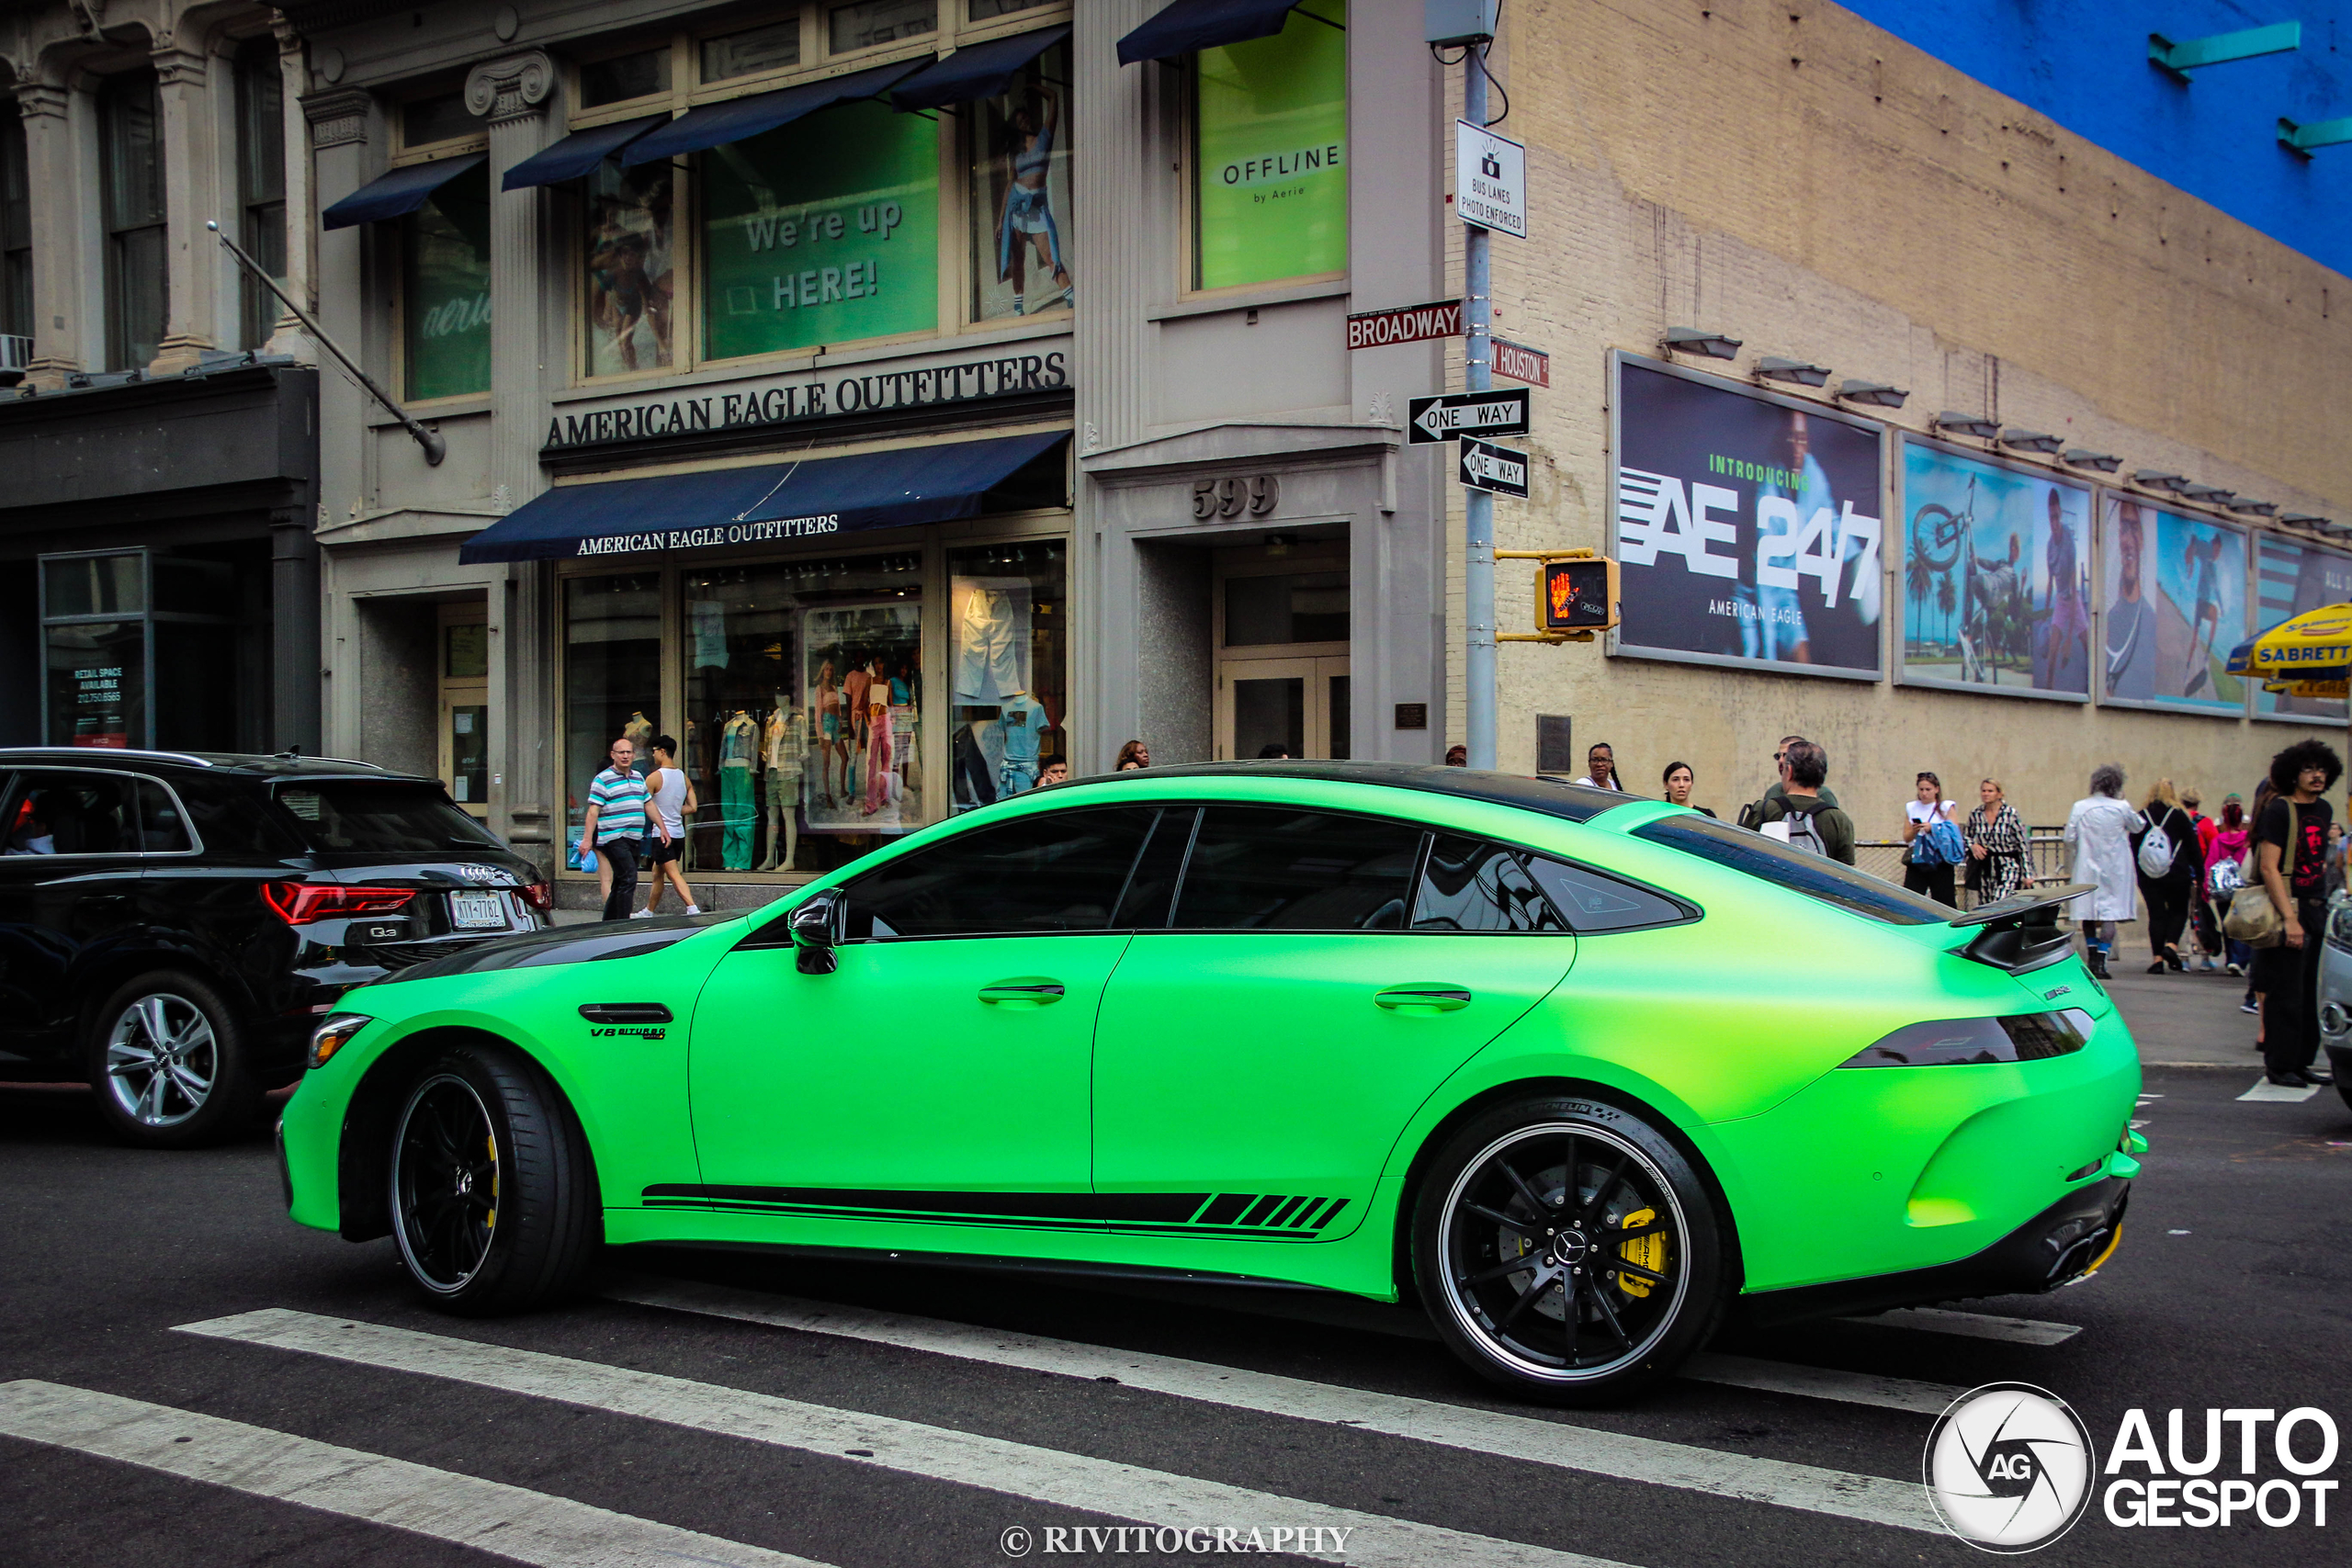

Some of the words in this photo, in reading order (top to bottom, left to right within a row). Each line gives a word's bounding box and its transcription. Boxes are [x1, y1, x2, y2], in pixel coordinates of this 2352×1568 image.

[1224, 145, 1339, 185] OFFLINE
[1254, 194, 1266, 204] by
[1272, 186, 1305, 199] Aerie
[1472, 178, 1486, 196] BUS
[1488, 184, 1510, 205] LANES
[745, 208, 844, 254] We're
[857, 200, 901, 242] up
[1462, 196, 1484, 217] PHOTO
[1486, 205, 1521, 230] ENFORCED
[774, 260, 877, 311] HERE!
[1349, 306, 1460, 347] BROADWAY
[1500, 346, 1541, 382] HOUSTON
[543, 397, 713, 448] AMERICAN
[721, 382, 826, 427] EAGLE
[835, 352, 1068, 413] OUTFITTERS
[1427, 409, 1461, 429] ONE
[1477, 404, 1514, 424] WAY
[1470, 454, 1489, 475] ONE
[1498, 461, 1521, 482] WAY
[1709, 454, 1810, 492] INTRODUCING
[1193, 475, 1280, 518] 599
[577, 533, 665, 556] AMERICAN
[669, 528, 725, 549] EAGLE
[729, 514, 839, 543] OUTFITTERS
[1757, 495, 1881, 609] 24/7
[1708, 599, 1766, 621] AMERICAN
[1771, 606, 1803, 626] EAGLE
[2259, 645, 2351, 663] SABRETT
[74, 670, 98, 679] RETAIL
[99, 667, 122, 678] SPACE
[80, 679, 119, 690] AVAILABLE
[477, 900, 500, 918] 7782
[370, 927, 397, 938] Q3
[591, 1028, 616, 1037] V8
[1527, 1101, 1592, 1115] MICHELIN
